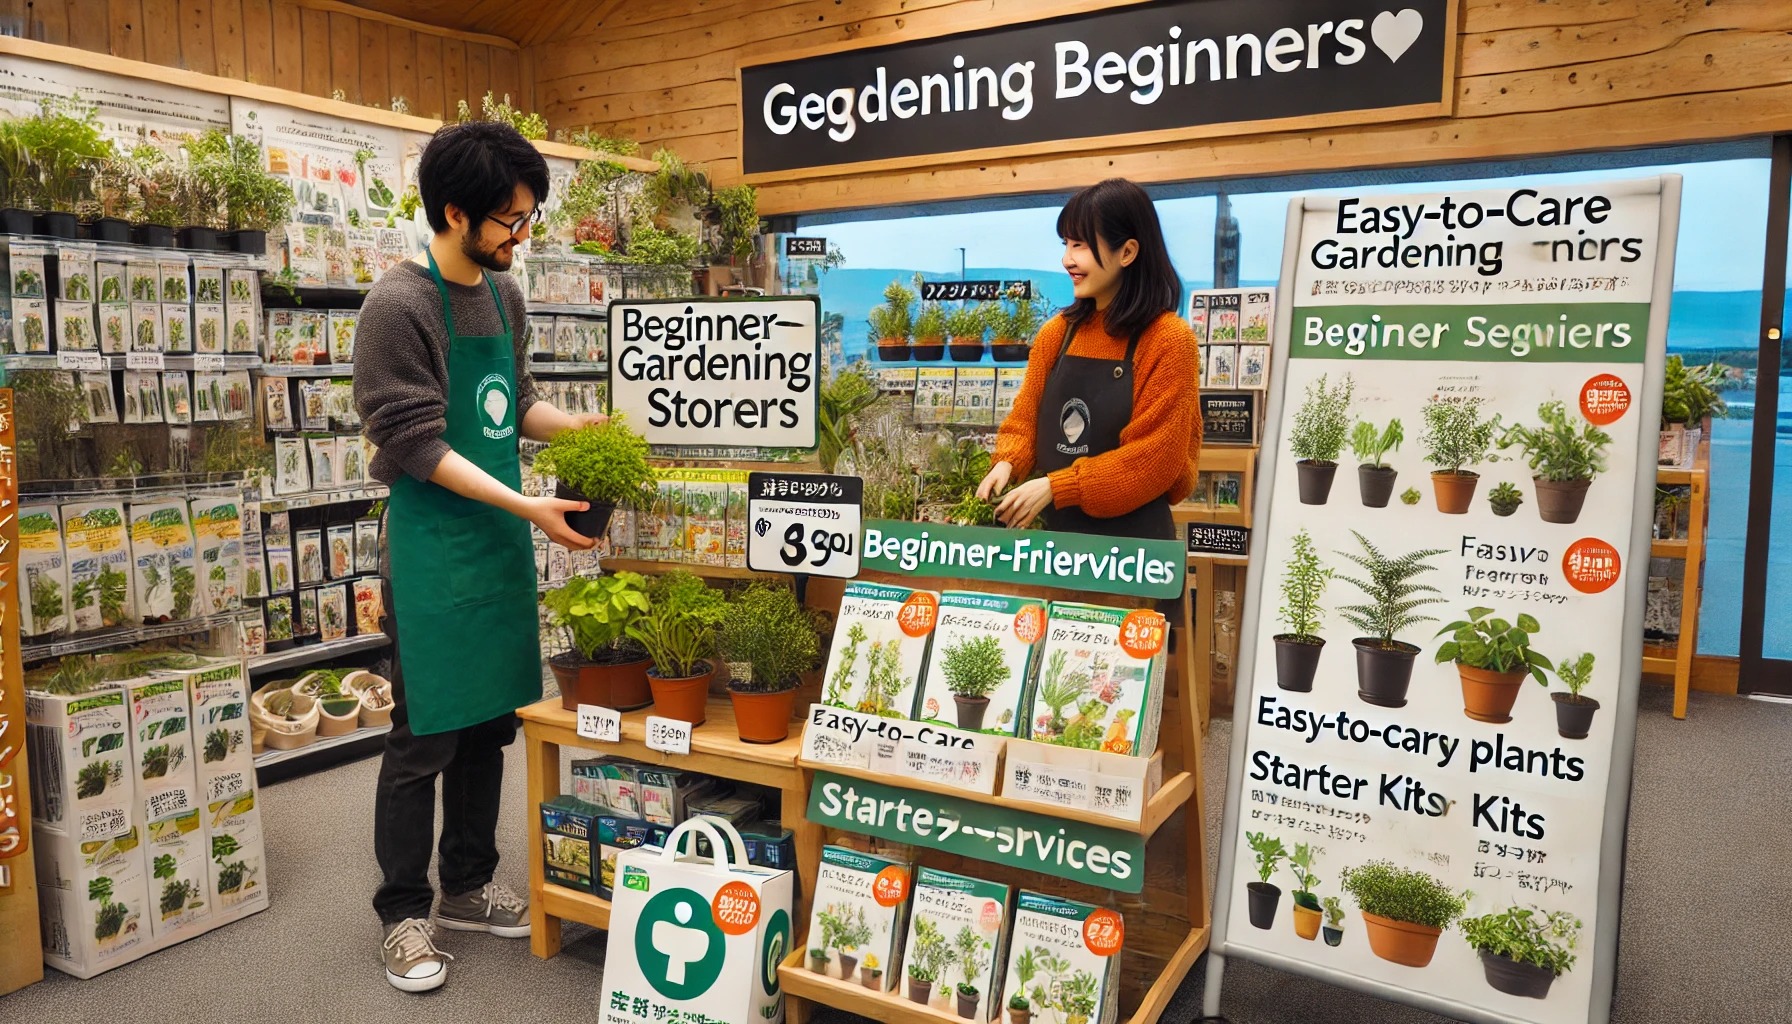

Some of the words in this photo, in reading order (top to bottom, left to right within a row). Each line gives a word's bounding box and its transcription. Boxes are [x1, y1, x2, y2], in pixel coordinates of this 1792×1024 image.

[763, 55, 1036, 142] Gegdening
[1054, 18, 1367, 106] Beginners
[1336, 188, 1612, 240] Easy-to-Care
[1311, 235, 1503, 276] Gardening
[1303, 314, 1450, 356] Beginer
[618, 342, 813, 393] Gardening
[647, 387, 800, 429] Storers
[863, 529, 1176, 586] Beginner-Friervicles
[1256, 695, 1460, 768] Easy-to-cary
[1470, 733, 1585, 782] plants
[1250, 750, 1369, 801] Starter
[1472, 793, 1546, 841] Kits
